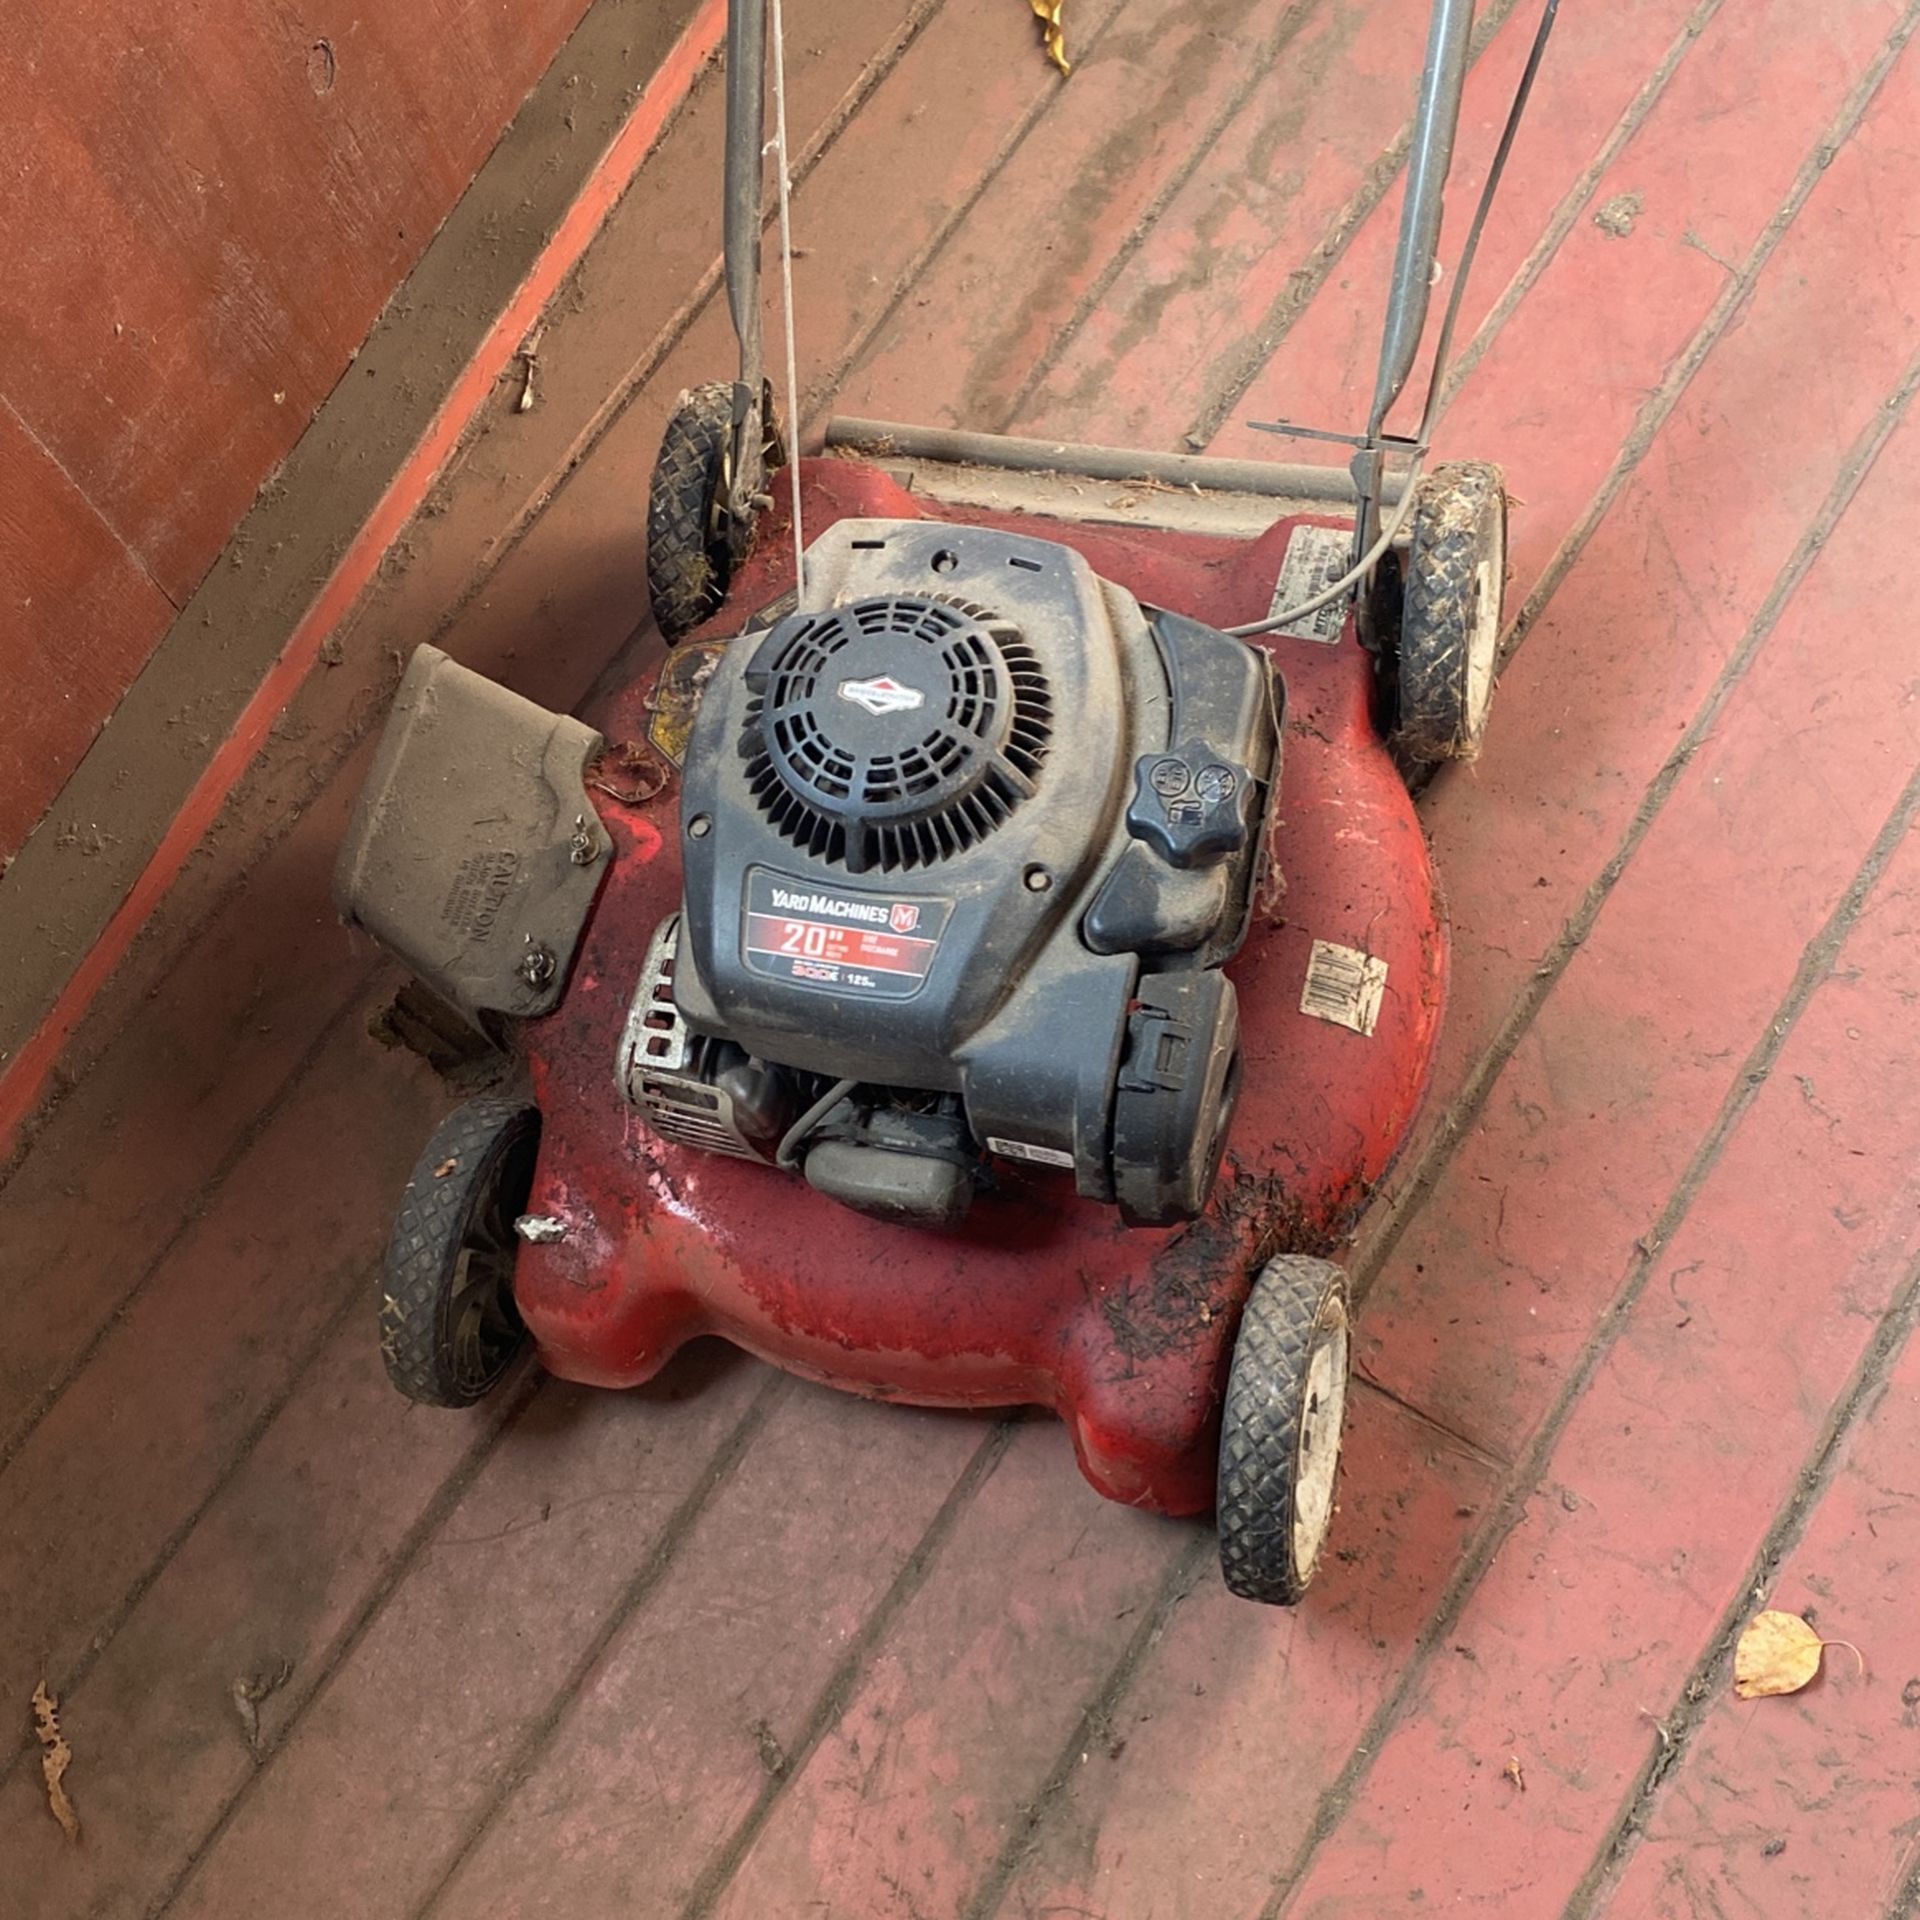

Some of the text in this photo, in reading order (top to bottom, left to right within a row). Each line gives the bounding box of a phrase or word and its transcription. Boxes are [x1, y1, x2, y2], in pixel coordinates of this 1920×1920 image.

[469, 850, 518, 943] CAUTION
[771, 888, 809, 912] YARD
[808, 895, 890, 924] MACHINES
